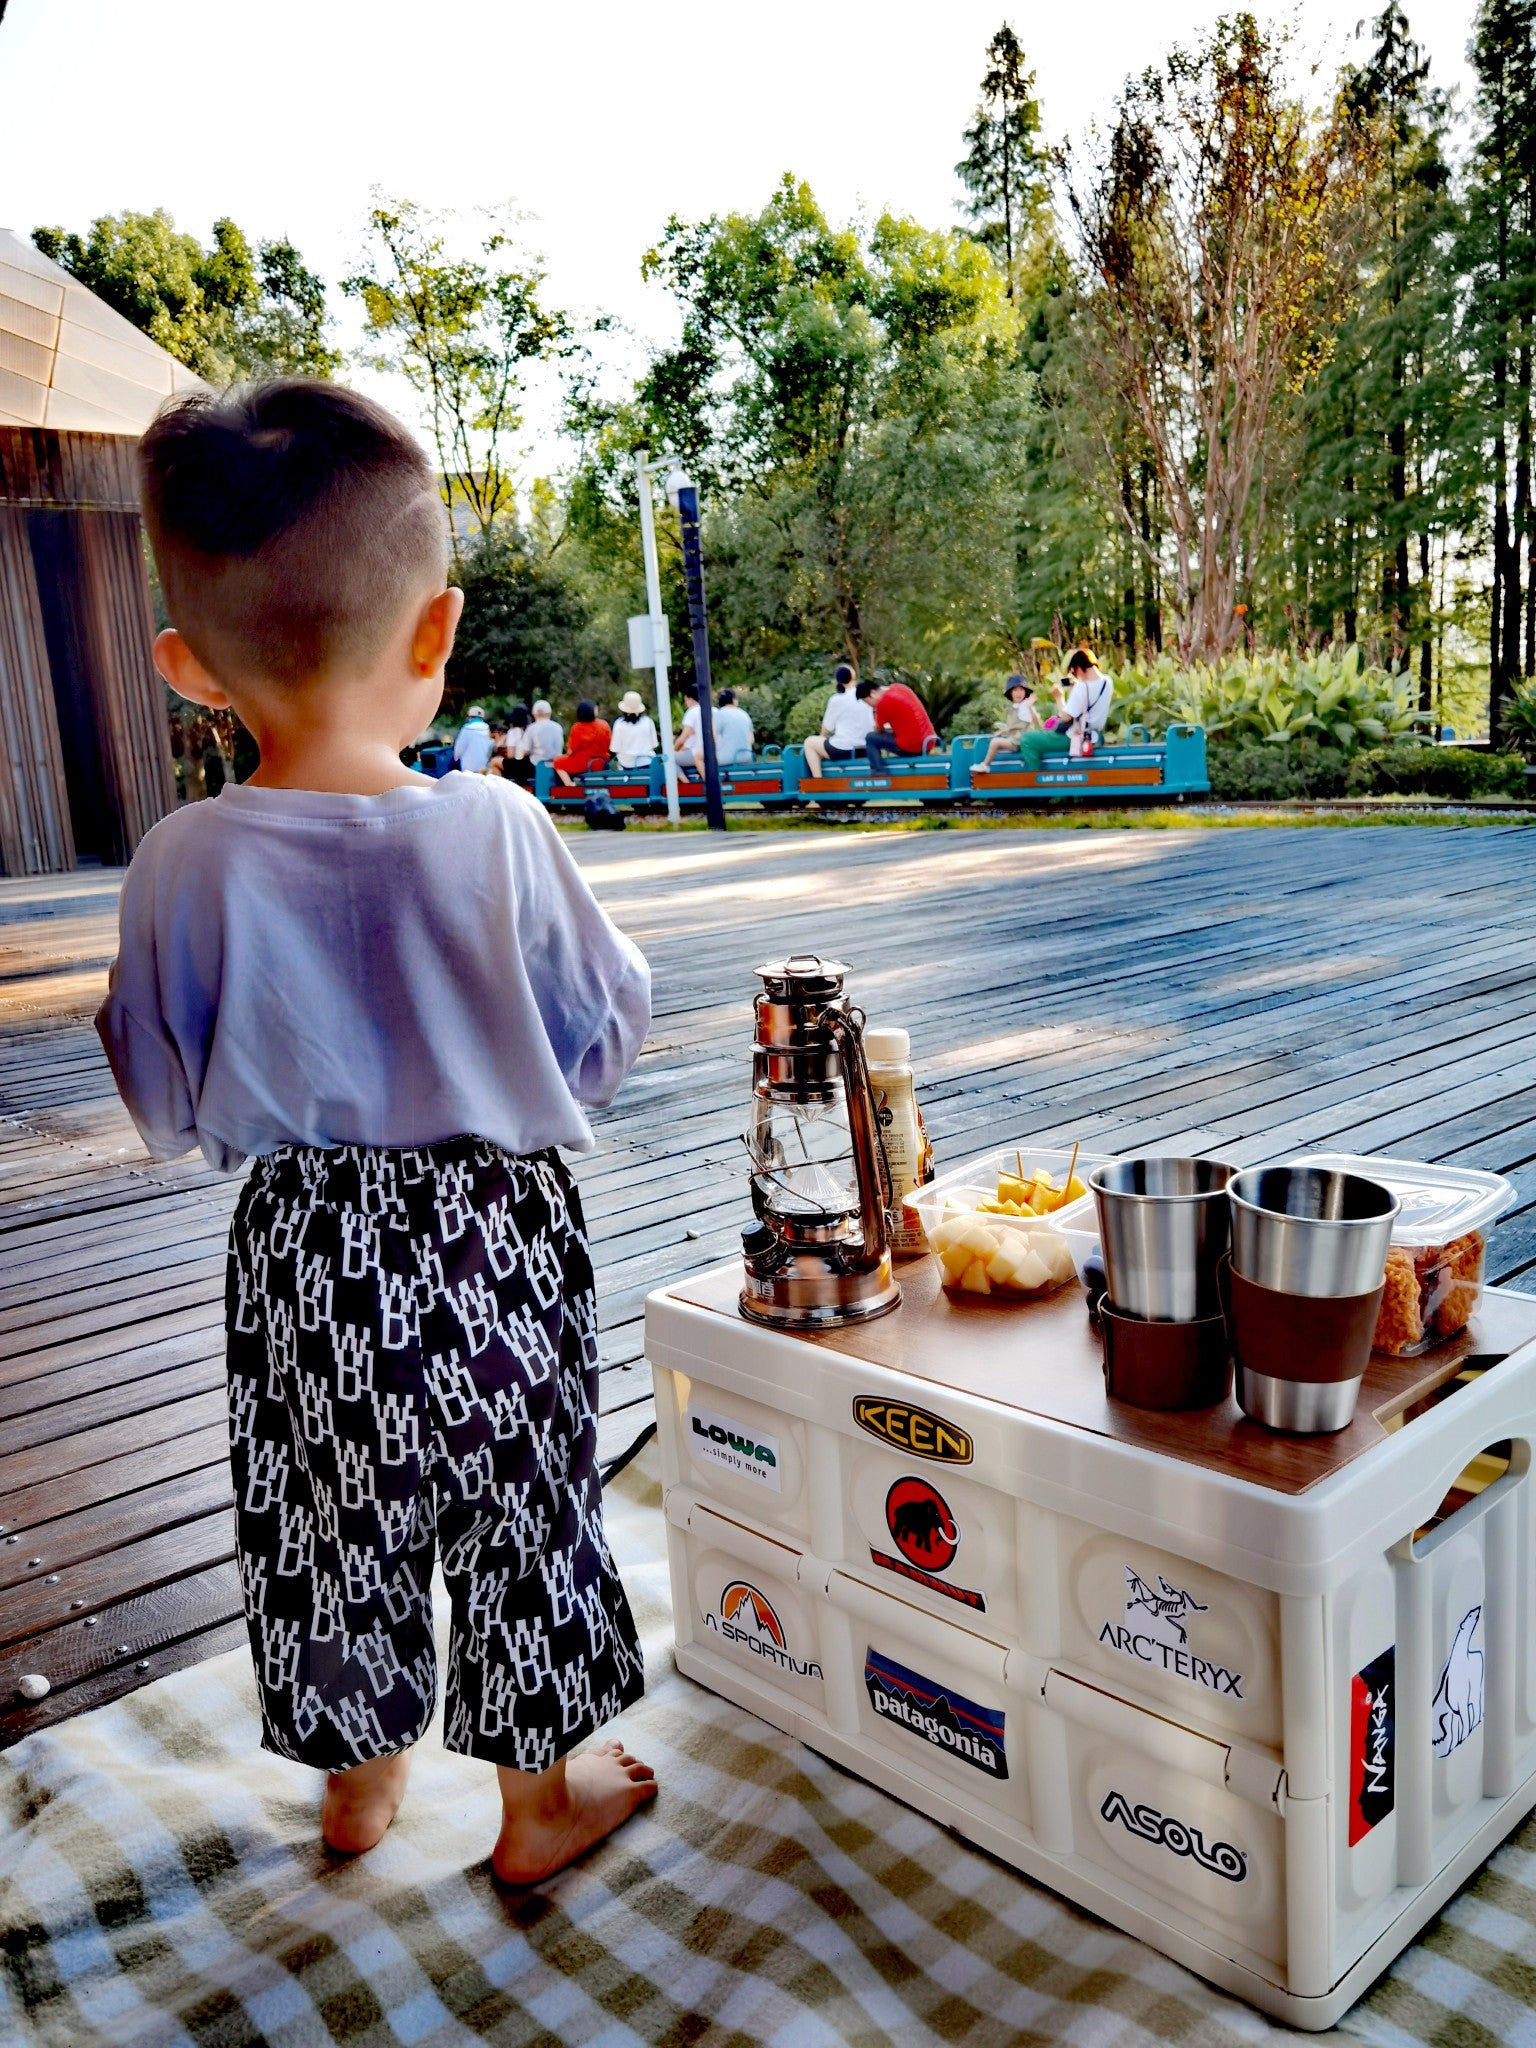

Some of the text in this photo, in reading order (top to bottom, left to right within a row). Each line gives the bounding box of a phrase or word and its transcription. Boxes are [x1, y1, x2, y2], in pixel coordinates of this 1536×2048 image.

[692, 1416, 776, 1468] LOWA
[860, 1404, 966, 1457] KEEN
[745, 1462, 767, 1479] more
[722, 1621, 824, 1680] SPORTIVA
[1099, 1621, 1244, 1699] ARC'TERYX
[873, 1689, 997, 1770] patagonia
[1361, 1684, 1389, 1793] NANGA
[1100, 1790, 1247, 1882] ASOLO
